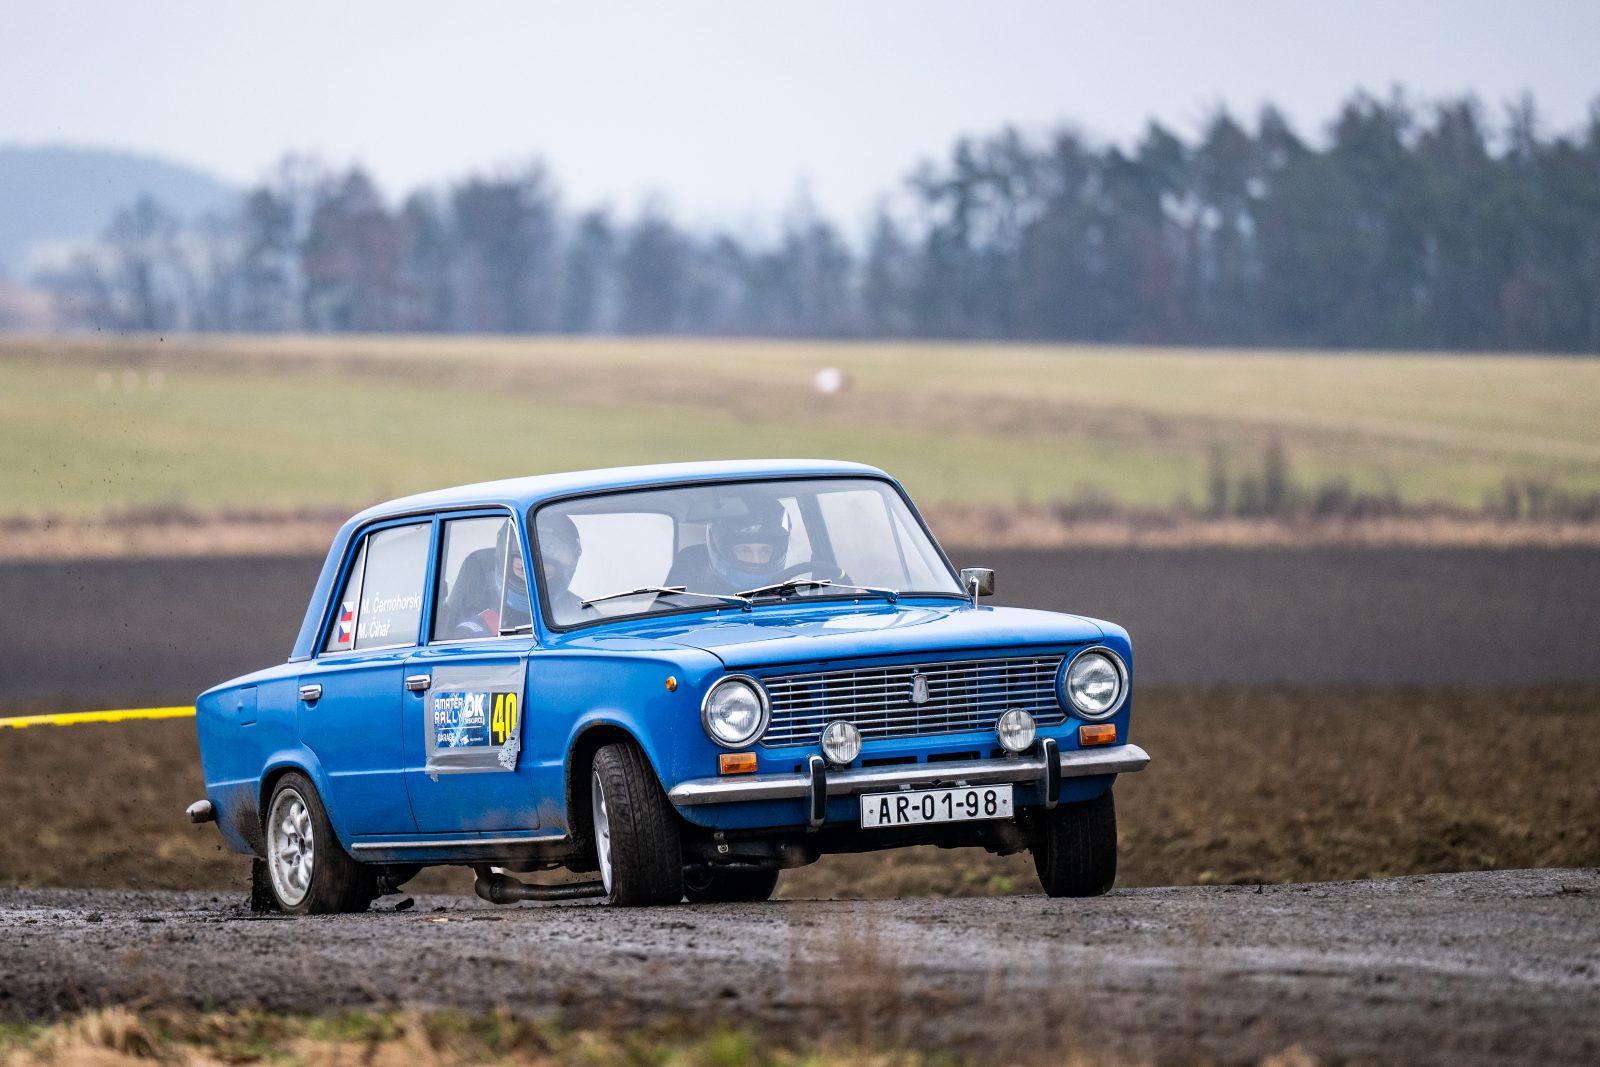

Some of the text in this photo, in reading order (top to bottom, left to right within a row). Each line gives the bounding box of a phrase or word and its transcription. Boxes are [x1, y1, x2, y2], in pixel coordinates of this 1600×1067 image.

[361, 599, 371, 614] M.
[358, 623, 367, 639] M.
[465, 692, 485, 718] OK
[434, 711, 462, 724] RALLY
[493, 693, 517, 743] 40
[879, 790, 997, 824] AR-01-98
